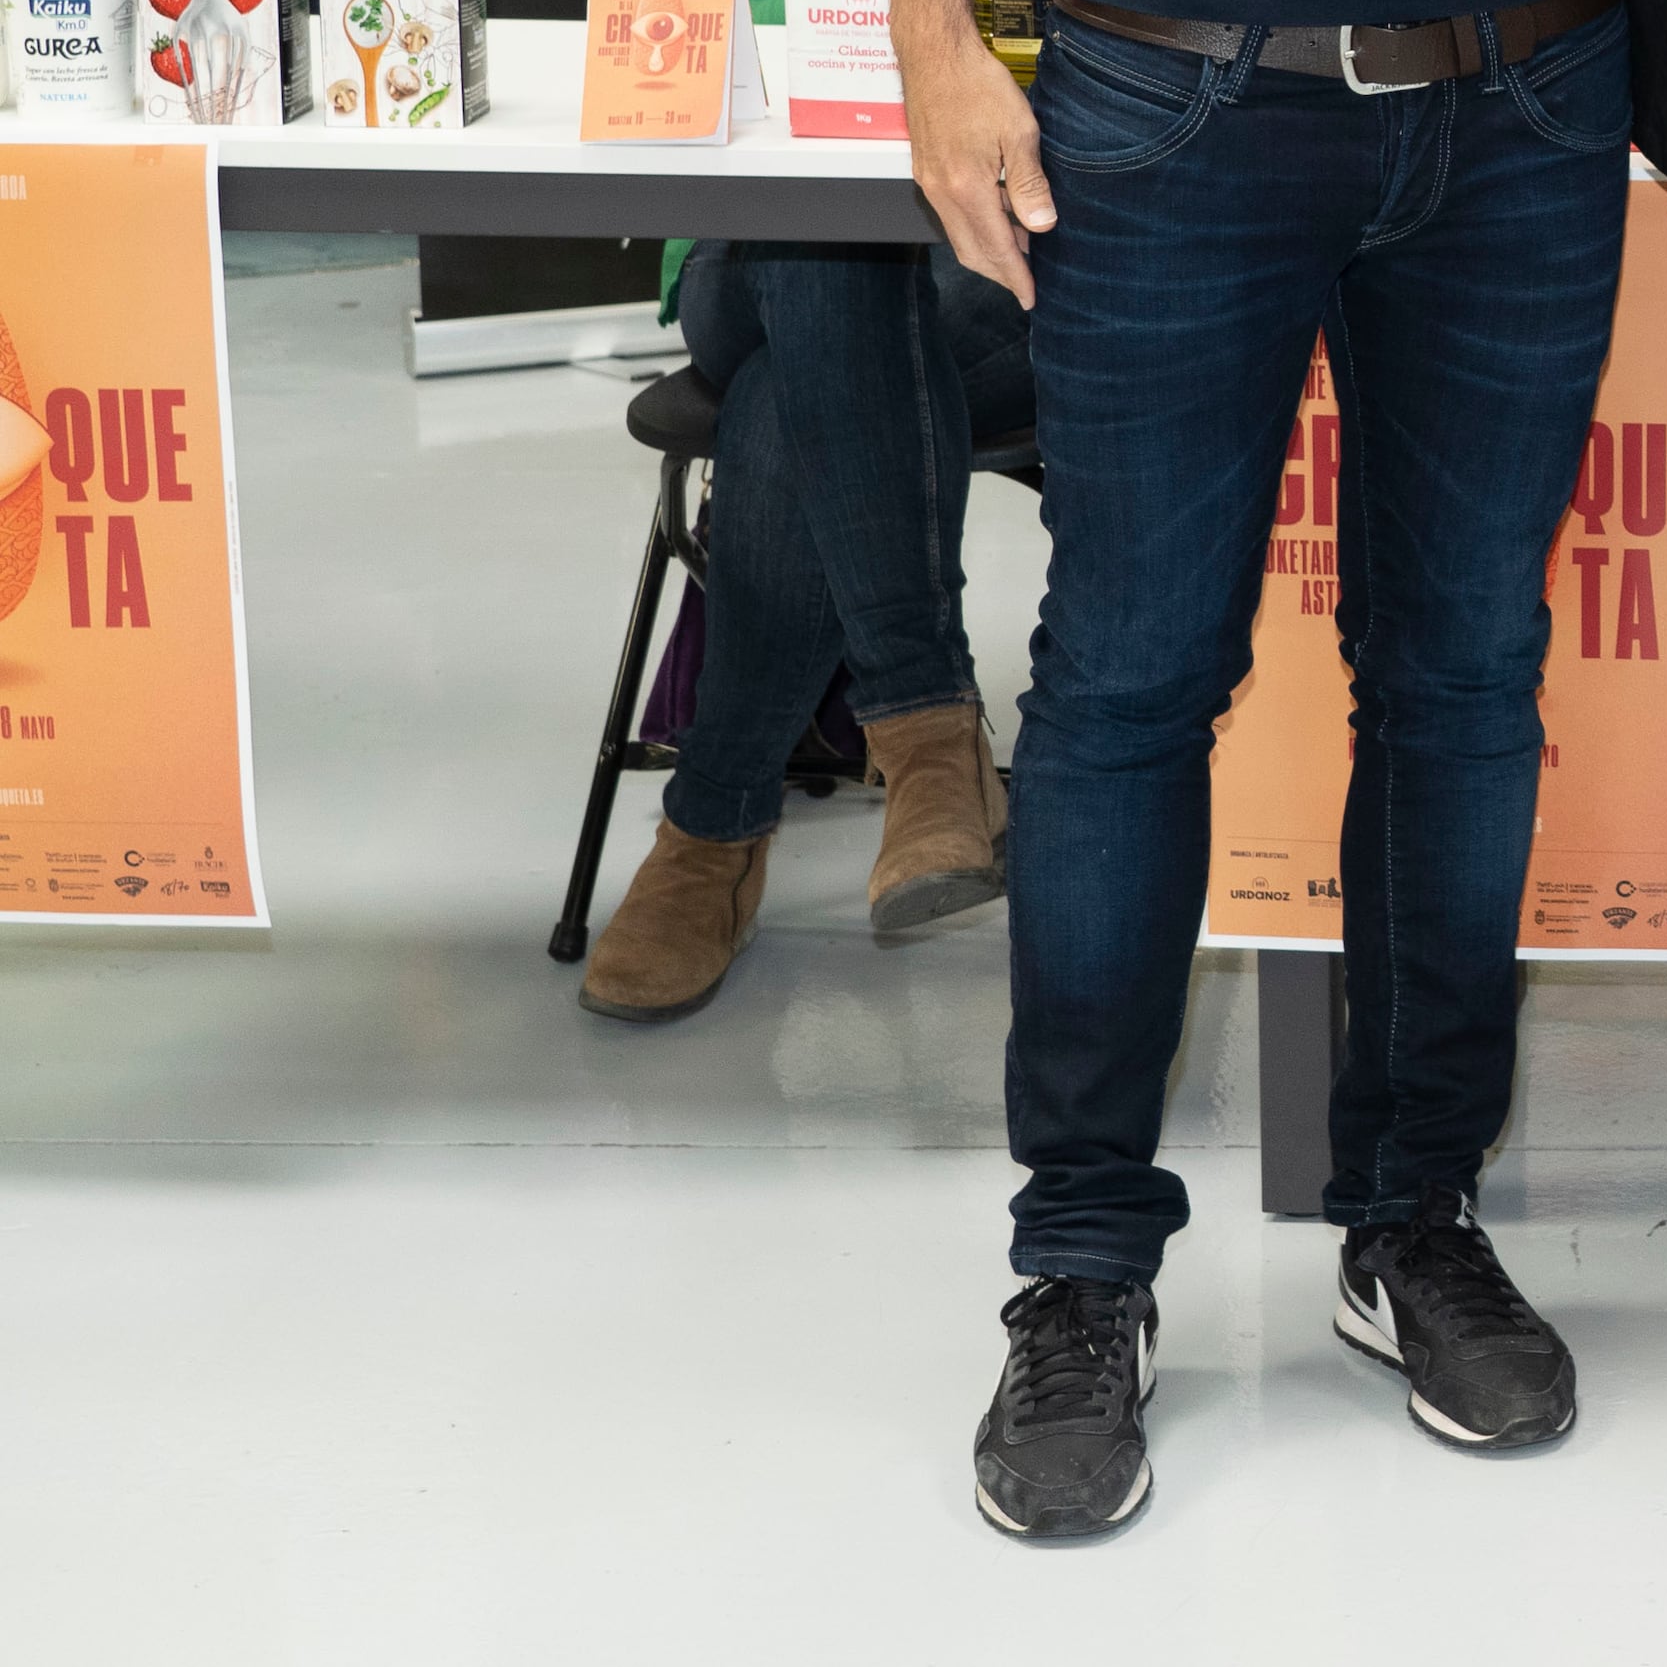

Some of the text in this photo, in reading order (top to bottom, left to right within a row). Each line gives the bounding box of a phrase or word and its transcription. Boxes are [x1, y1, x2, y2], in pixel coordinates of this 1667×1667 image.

[687, 12, 725, 43] QUE
[685, 44, 709, 74] TA
[808, 58, 857, 72] cocina y
[838, 45, 888, 58] Clásica
[45, 387, 193, 503] QUE
[55, 515, 151, 629] TA
[1572, 547, 1659, 660] TA
[20, 715, 56, 741] MAYO
